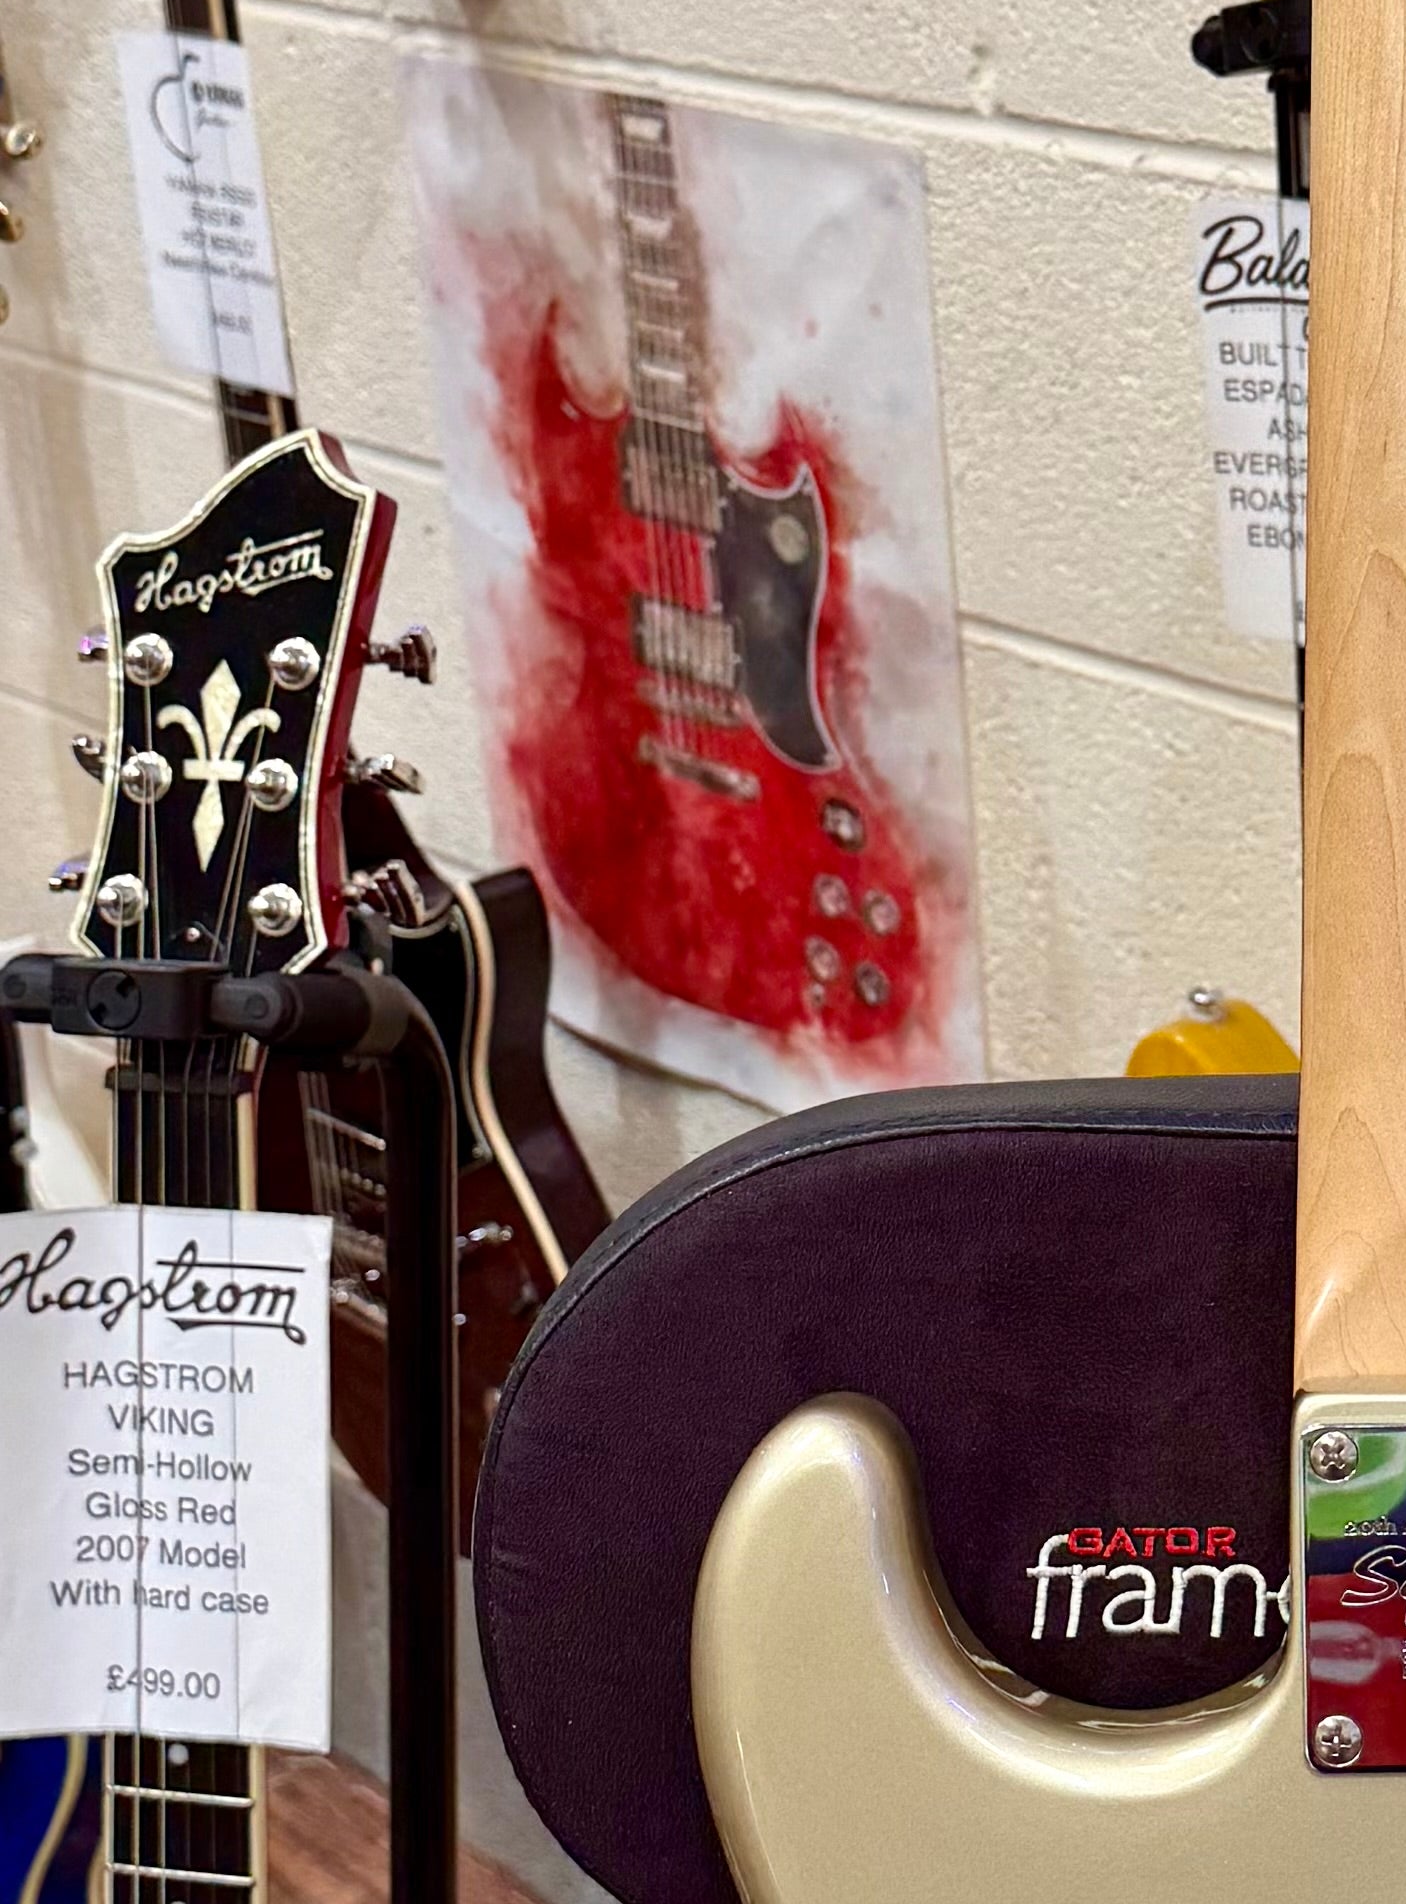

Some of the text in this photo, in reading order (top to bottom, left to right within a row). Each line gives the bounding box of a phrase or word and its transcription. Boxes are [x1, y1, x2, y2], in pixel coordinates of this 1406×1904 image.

[1223, 378, 1309, 407] ESPAD
[134, 528, 334, 614] Hagstrom
[0, 1227, 307, 1346] Hagstrom
[62, 1359, 255, 1395] HAGSTROM
[107, 1403, 215, 1437] VIKING
[67, 1448, 252, 1482] Semi-Hollow
[85, 1491, 237, 1526] Gloss Red
[159, 1538, 247, 1570] Model
[1066, 1525, 1238, 1558] GATOR
[49, 1578, 269, 1615] With hard case
[105, 1663, 221, 1700] £499.00
